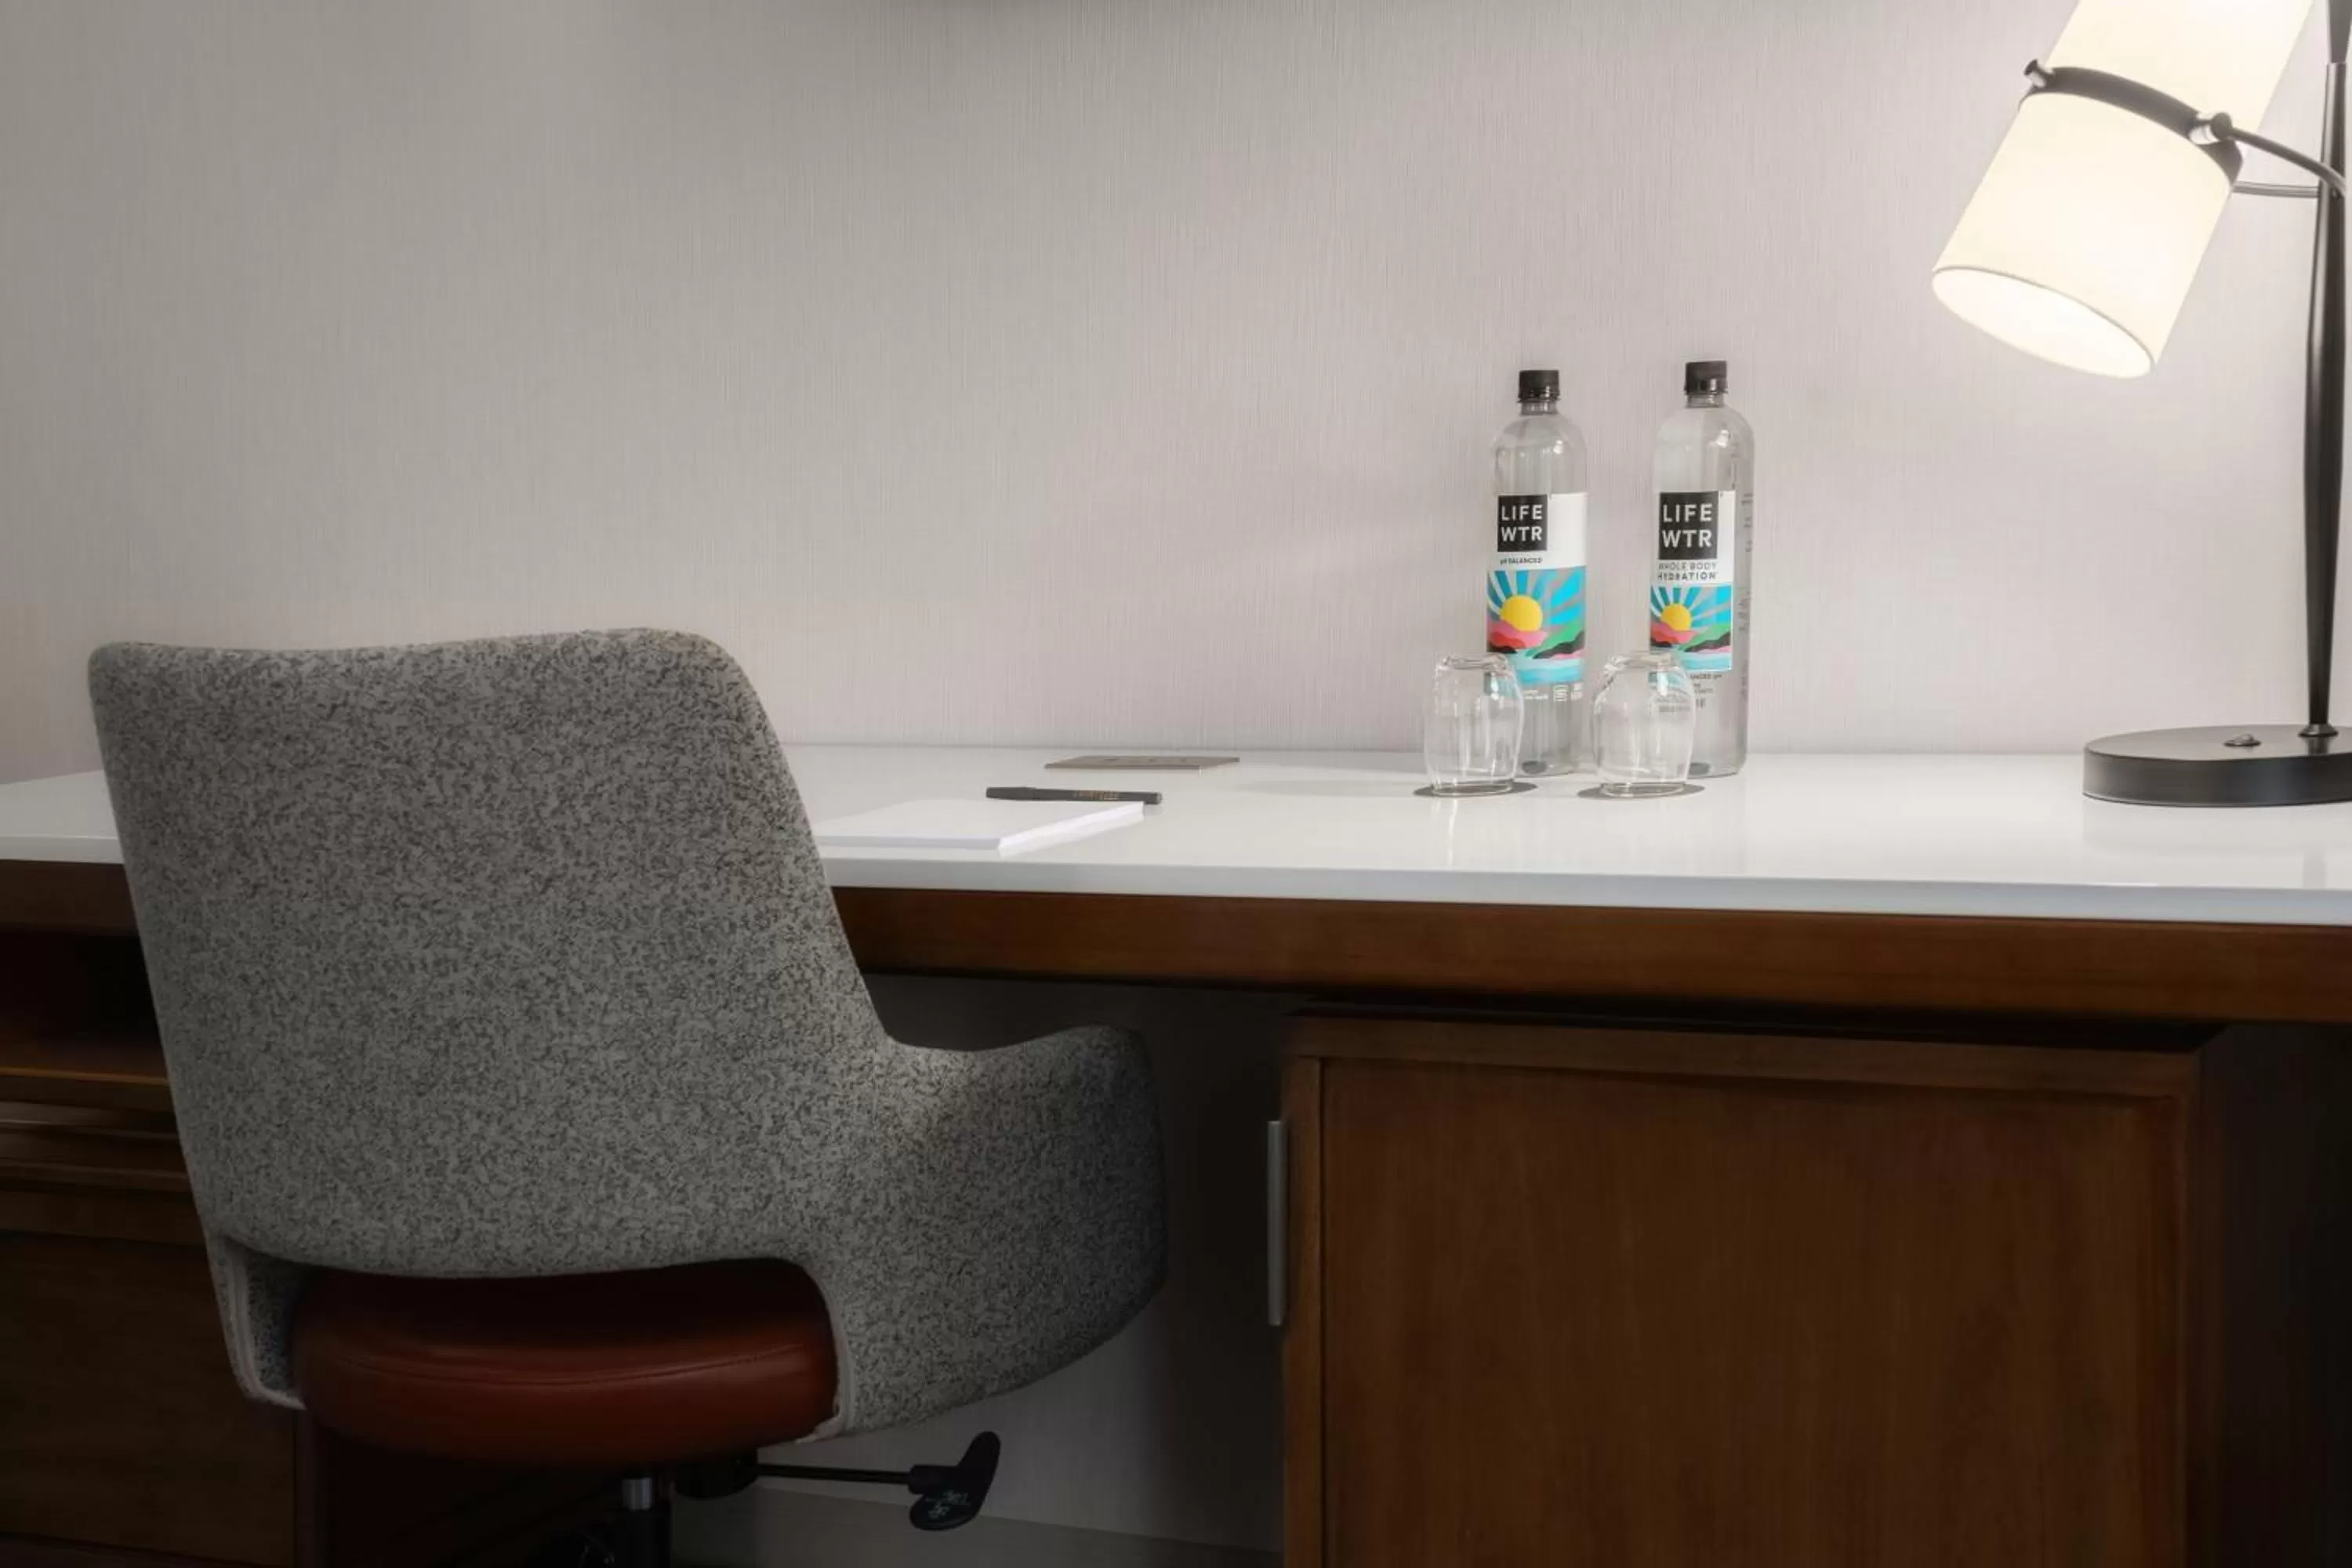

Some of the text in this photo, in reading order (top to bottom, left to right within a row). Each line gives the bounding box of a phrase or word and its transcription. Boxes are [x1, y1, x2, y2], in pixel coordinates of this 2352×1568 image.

[1501, 504, 1543, 521] LIFE
[1662, 503, 1713, 523] LIFE
[1501, 526, 1543, 542] WTR
[1661, 529, 1713, 548] WTR
[1690, 561, 1717, 571] BODY
[1657, 572, 1716, 581] HYDRATION
